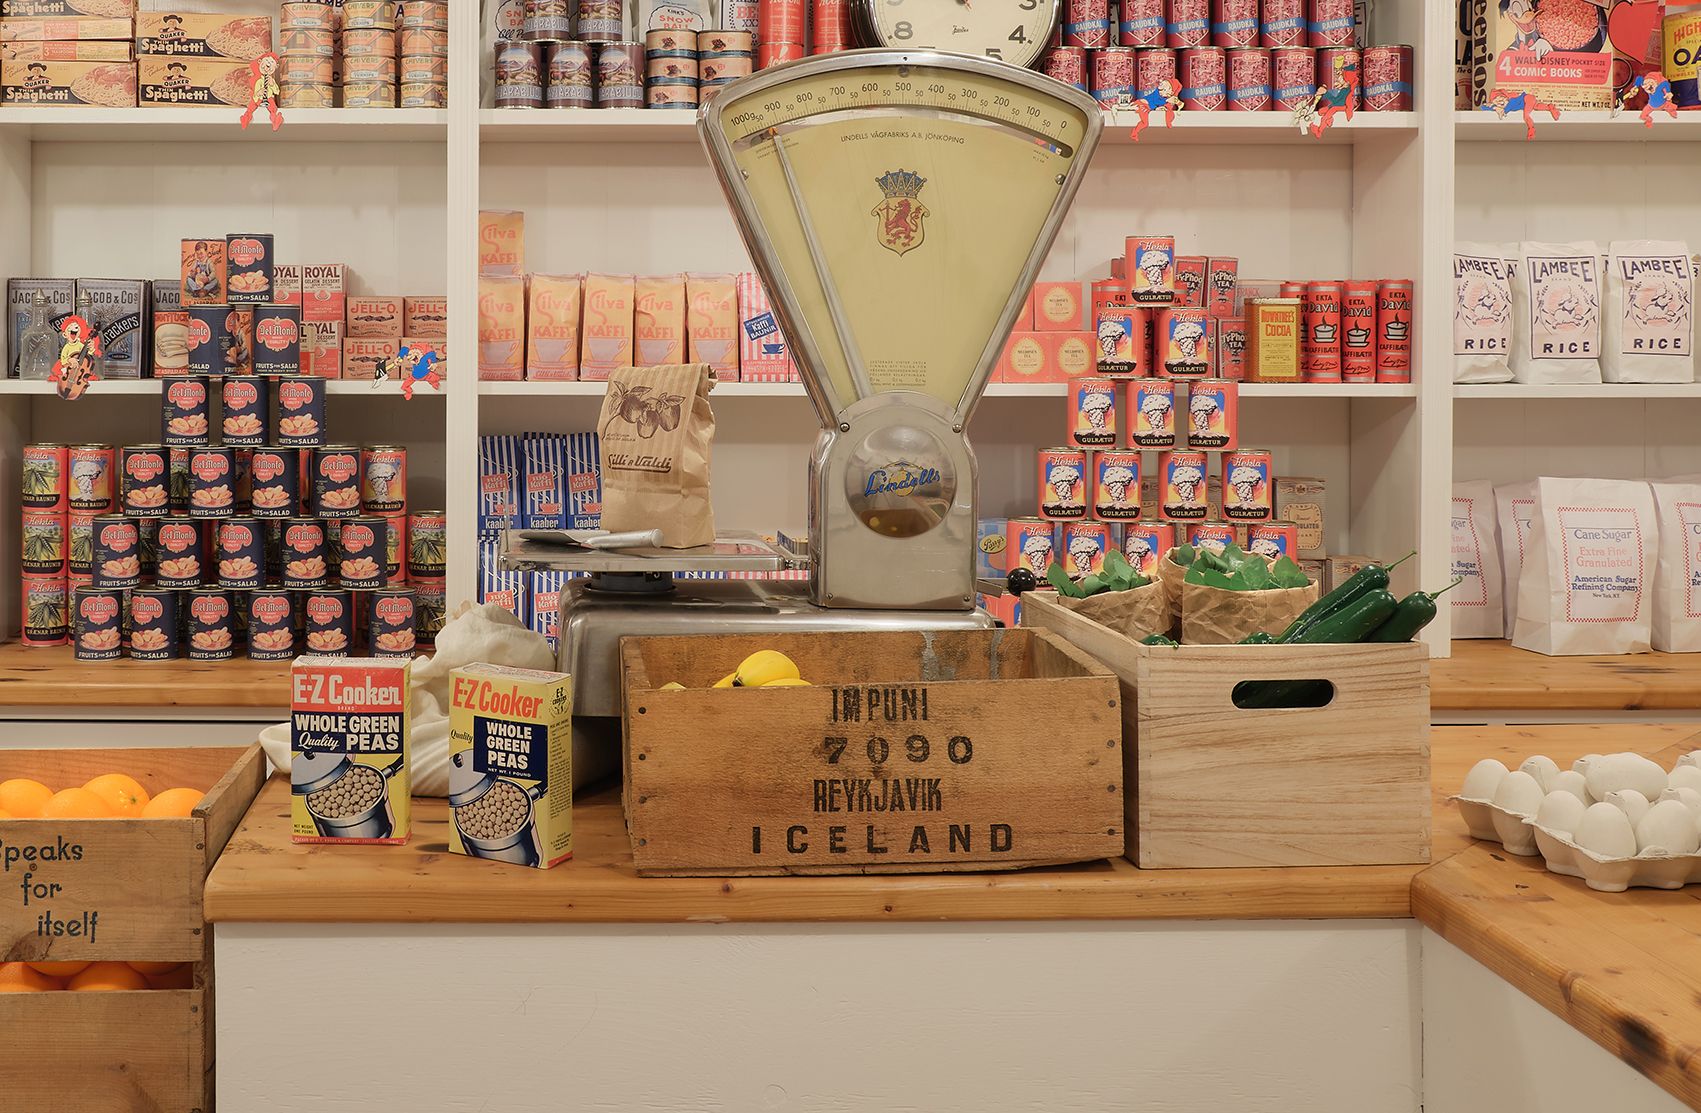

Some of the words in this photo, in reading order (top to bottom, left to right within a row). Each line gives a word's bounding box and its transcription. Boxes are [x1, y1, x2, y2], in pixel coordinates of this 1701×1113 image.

[2, 1, 65, 16] Spaghetti
[659, 15, 694, 24] SNOW
[160, 31, 186, 39] QUAKER
[894, 21, 914, 40] 8
[1008, 25, 1027, 44] 4
[141, 39, 204, 54] Spaghetti
[1499, 56, 1512, 76] 4
[1540, 57, 1571, 66] DISNEY
[1514, 67, 1547, 77] COMIC
[1550, 68, 1583, 78] BOOKS
[24, 79, 50, 88] QUAKER
[163, 79, 190, 87] QUAKER
[861, 82, 879, 92] 600
[895, 82, 912, 92] 500
[928, 84, 945, 94] 400
[6, 87, 69, 104] Spaghetti
[145, 86, 208, 101] Spaghetti
[829, 86, 846, 96] 700
[850, 91, 859, 99] 50
[882, 89, 891, 97] 50
[915, 90, 924, 98] 50
[948, 92, 957, 101] 50
[961, 88, 978, 99] 300
[796, 92, 813, 103] 800
[817, 96, 826, 104] 50
[980, 99, 989, 107] 50
[993, 95, 1010, 107] 200
[764, 101, 781, 113] 900
[786, 103, 795, 112] 50
[1011, 107, 1020, 116] 50
[1026, 105, 1041, 118] 100
[756, 113, 764, 122] 50
[1042, 119, 1051, 128] 50
[1060, 119, 1068, 130] 0
[481, 253, 518, 265] KAFFI
[304, 267, 340, 278] ROYAL
[1532, 260, 1593, 284] LAMBEE
[1622, 259, 1687, 281] LAMBEE
[86, 291, 114, 304] ACOB
[1309, 301, 1339, 313] David
[1342, 305, 1373, 317] David
[534, 325, 571, 337] KAFFI
[588, 325, 625, 337] KAFFI
[750, 324, 777, 339] BAUNIR
[751, 319, 769, 332] Kaffi
[1265, 324, 1292, 337] COCOA
[638, 327, 674, 339] KAFFI
[693, 327, 731, 339] KAFFI
[1464, 337, 1507, 350] RICE
[1542, 341, 1590, 354] RICE
[1632, 338, 1682, 349] RICE
[530, 517, 559, 529] kaaber
[1574, 529, 1601, 540] Cane
[1602, 529, 1632, 542] Sugar
[1580, 546, 1605, 556] Extra
[1607, 547, 1627, 557] Fine
[1576, 556, 1633, 569] Granulated
[237, 580, 258, 588] SALAD
[1574, 575, 1613, 583] American
[1615, 575, 1637, 585] Sugar
[1571, 583, 1605, 593] Refining
[1605, 583, 1639, 593] Company
[293, 673, 325, 705] E-Z
[328, 675, 402, 706] Cooker
[453, 677, 480, 710] E-Z
[479, 680, 543, 719] Cooker
[832, 687, 928, 723] IMPUNI
[295, 713, 347, 733] WHOLE
[348, 714, 400, 734] GREEN
[450, 728, 473, 745] Quality
[486, 721, 532, 740] WHOLE
[298, 731, 340, 751] Quality
[346, 733, 399, 751] PEAS
[486, 736, 531, 754] GREEN
[825, 734, 974, 765] 7090
[487, 753, 528, 770] PEAS
[813, 777, 942, 813] REYKJAVIK
[752, 823, 1013, 854] ICELAND
[20, 872, 63, 906] for
[37, 910, 99, 944] itself
